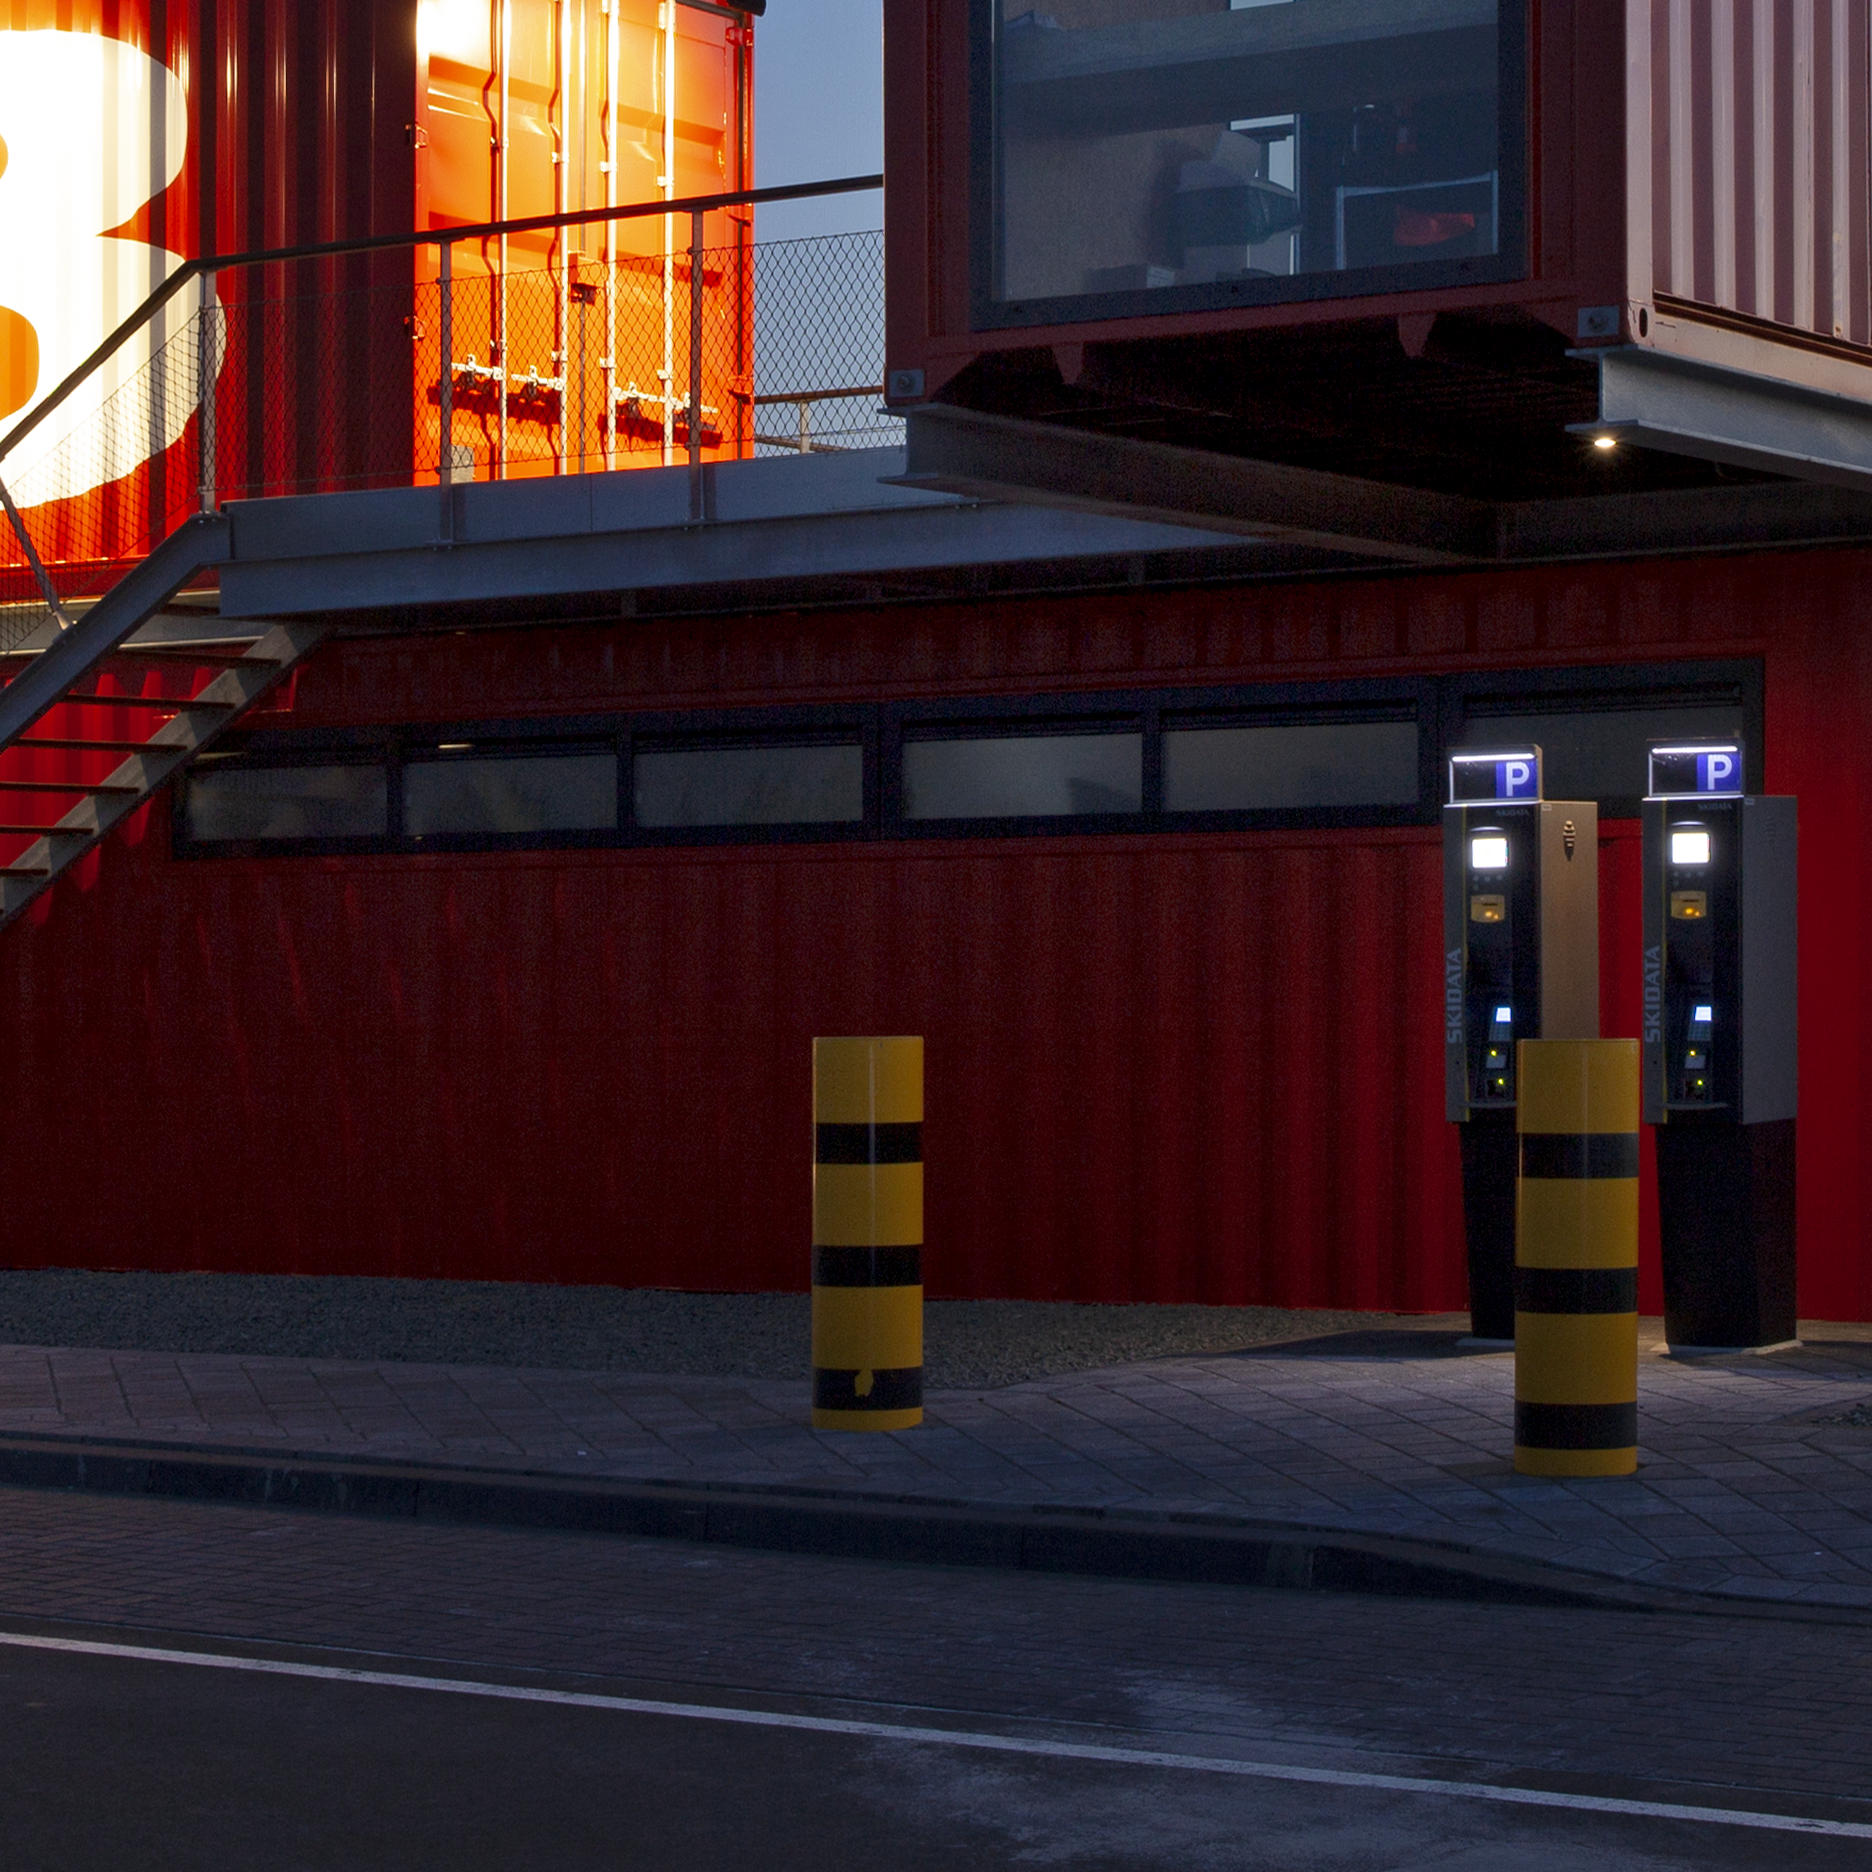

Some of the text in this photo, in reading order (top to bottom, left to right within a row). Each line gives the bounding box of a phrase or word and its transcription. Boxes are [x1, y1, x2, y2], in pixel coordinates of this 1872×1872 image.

[1505, 761, 1530, 797] P
[1707, 754, 1733, 790] P
[1446, 948, 1463, 1044] SKIDATA
[1644, 945, 1661, 1043] SKIDATA
